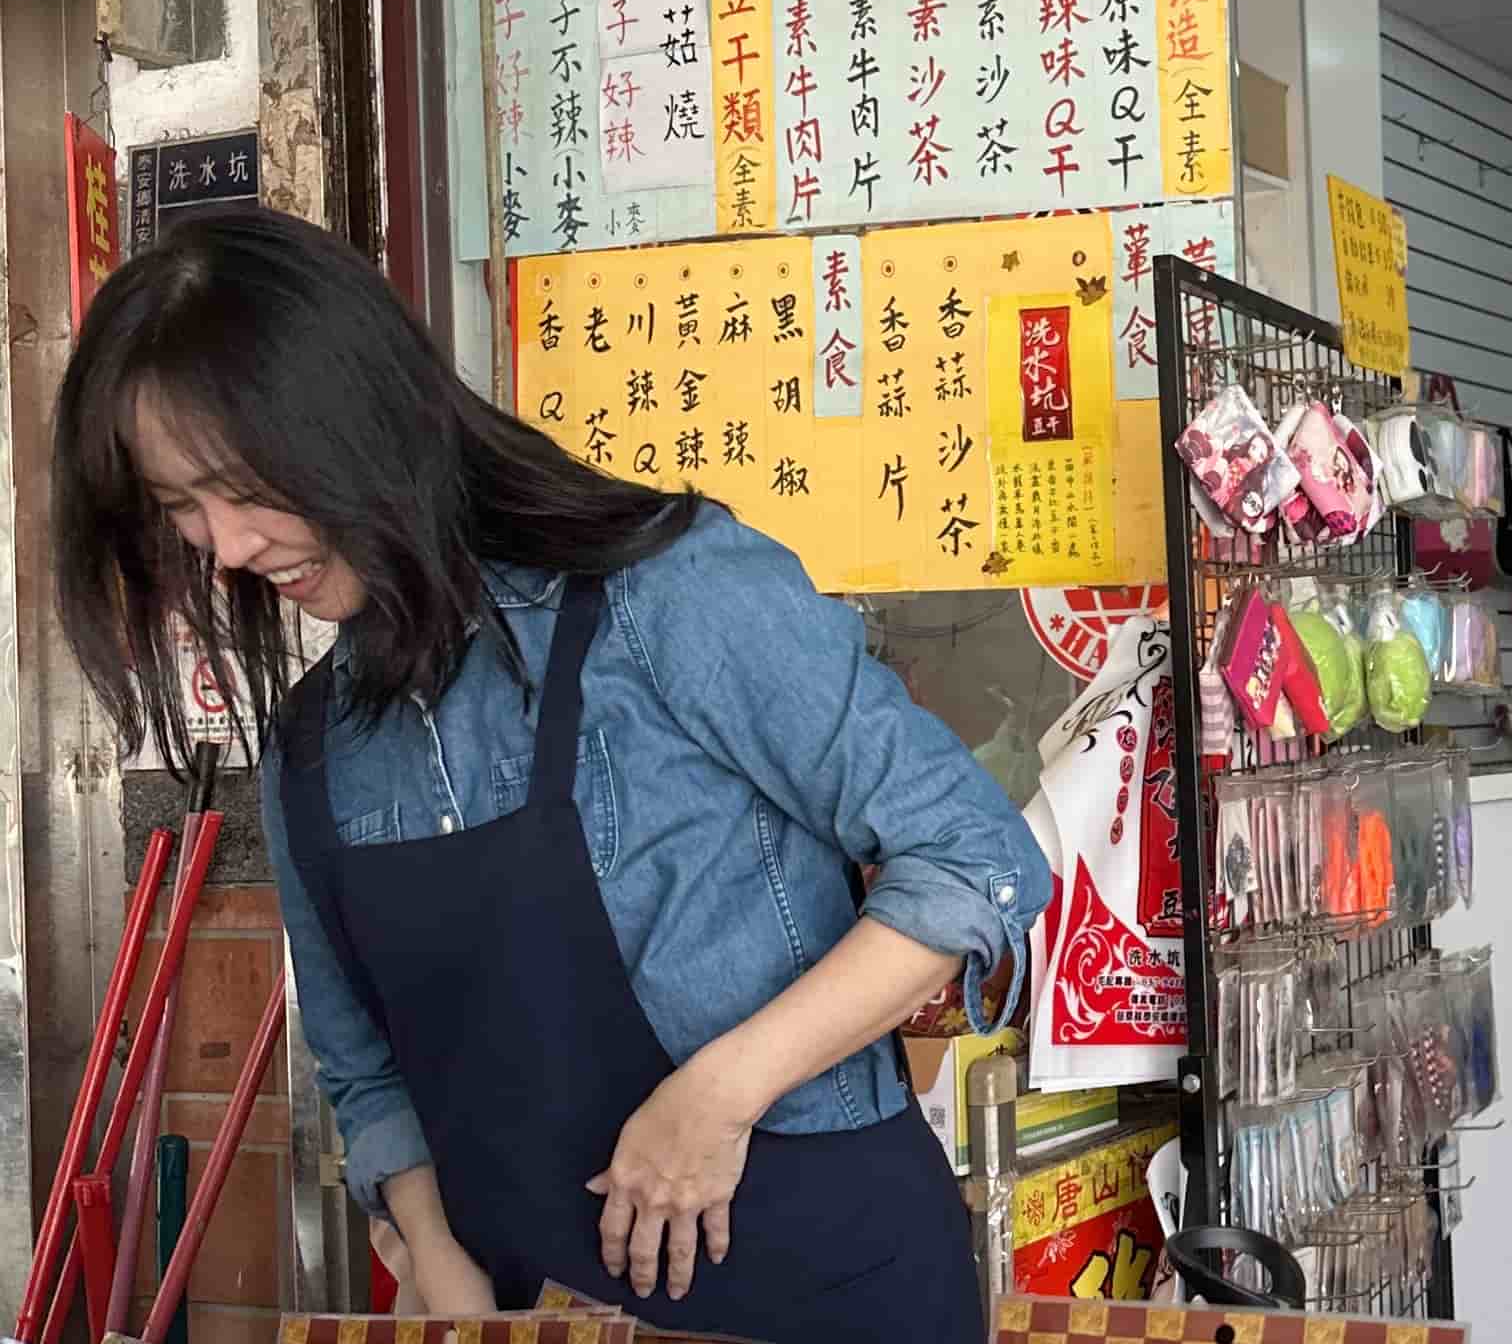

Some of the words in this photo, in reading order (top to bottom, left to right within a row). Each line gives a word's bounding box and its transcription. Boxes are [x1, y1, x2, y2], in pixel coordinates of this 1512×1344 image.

[168, 151, 250, 192] 洗水坑
[821, 250, 858, 389] 素食
[1021, 317, 1070, 412] 洗水坑
[1119, 222, 1160, 369] 葷食
[674, 292, 709, 473] 黃金辣
[768, 294, 811, 498] 黑胡椒
[877, 296, 913, 522] 香蒜片
[935, 286, 982, 556] 香蒜沙茶
[1031, 414, 1062, 437] 豆干
